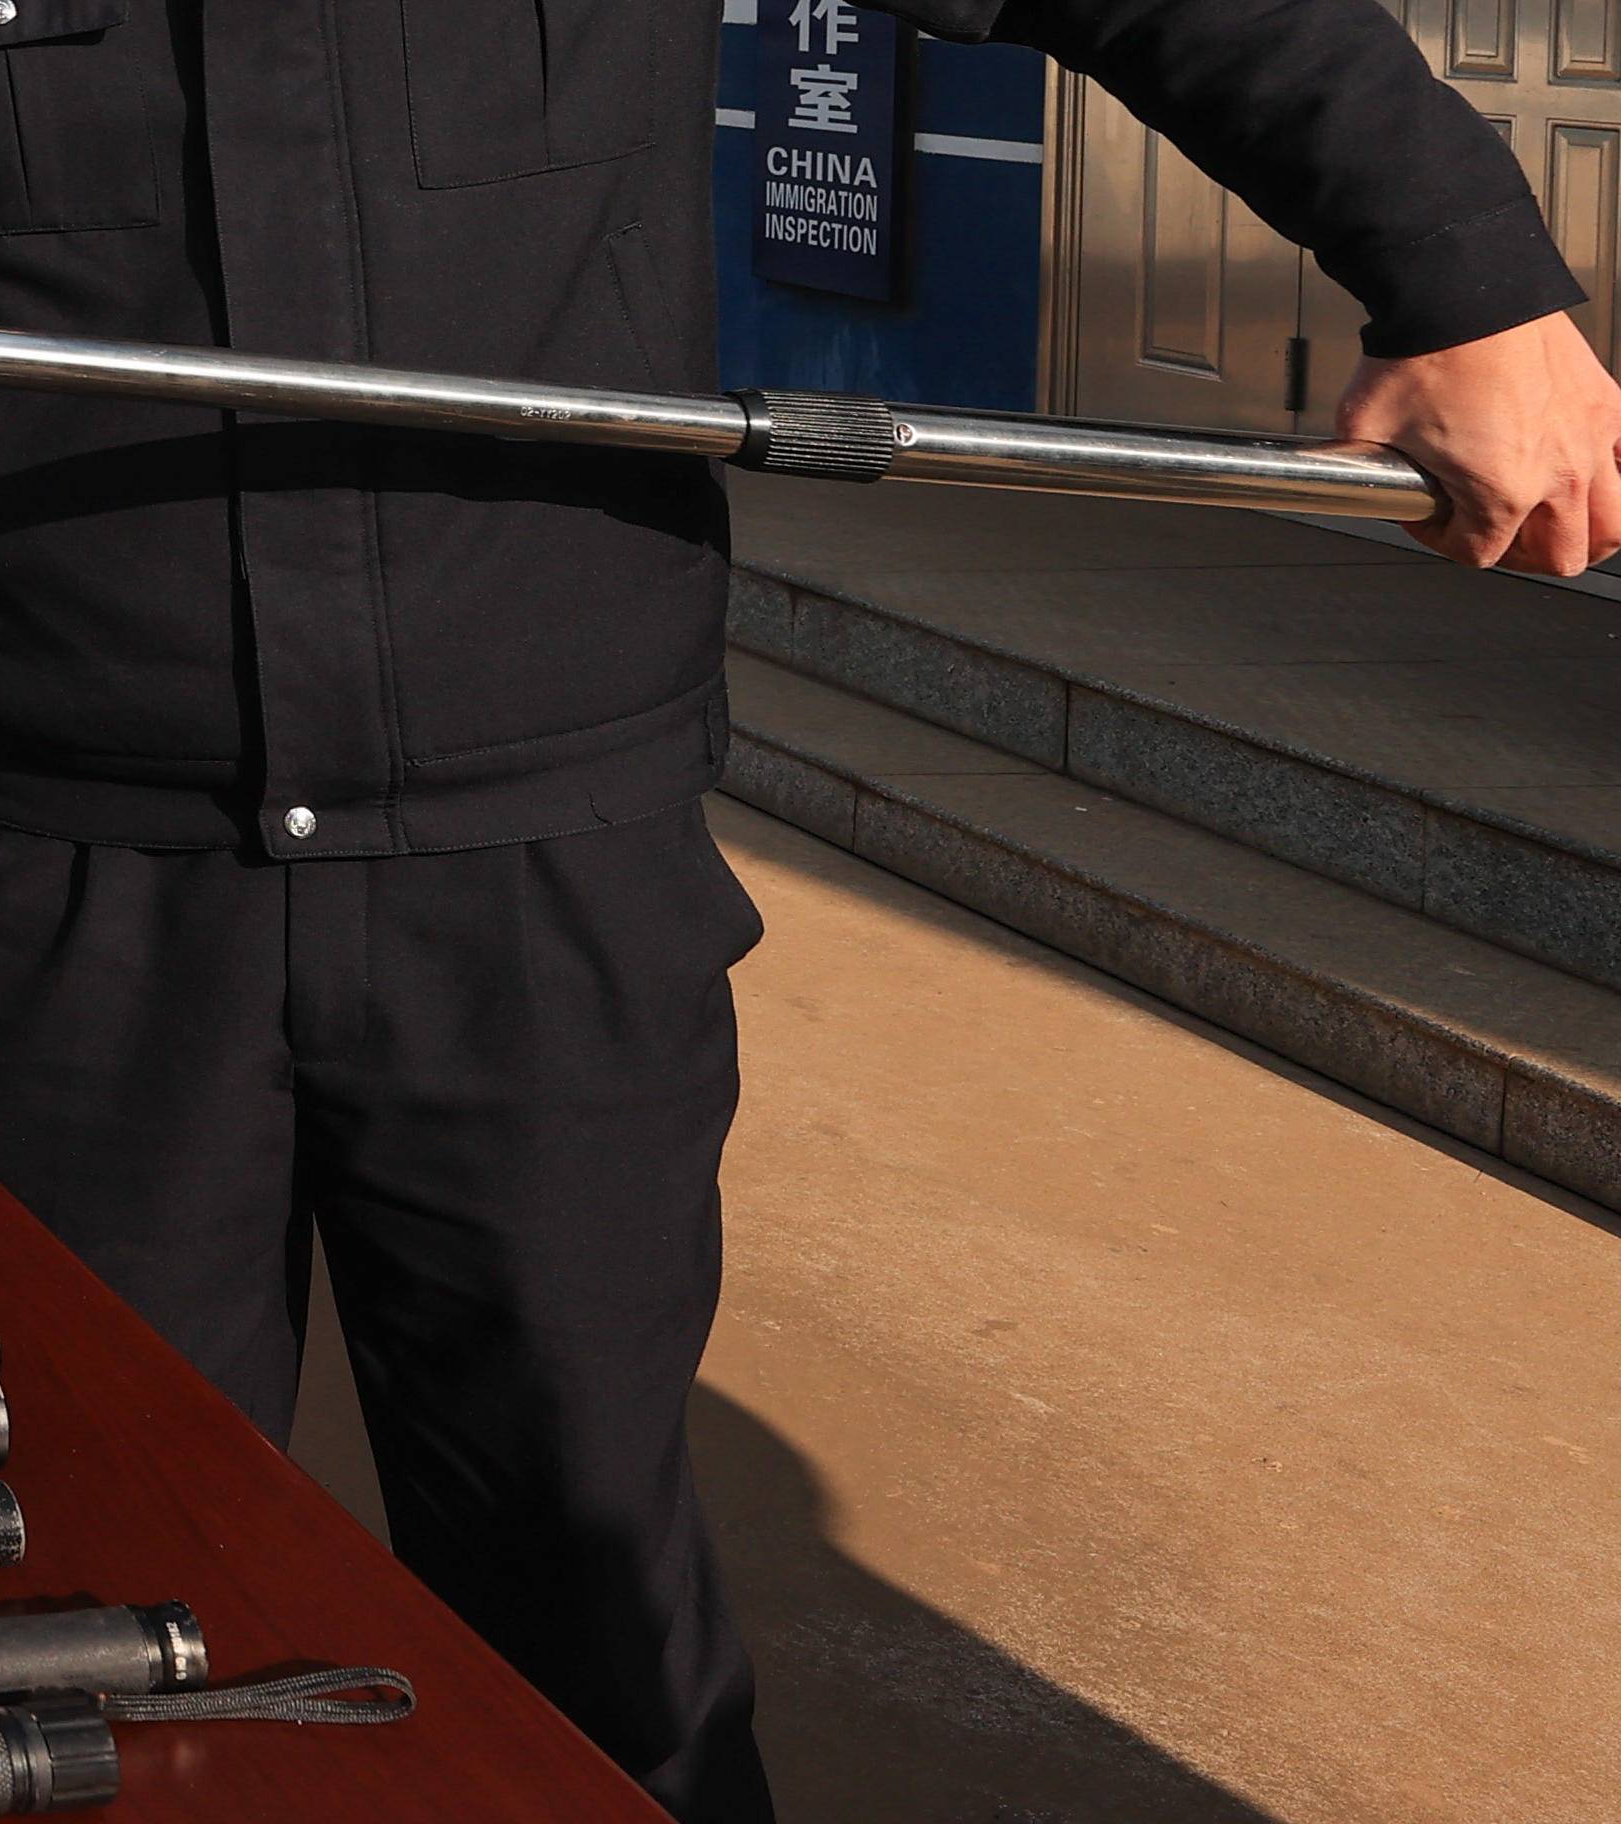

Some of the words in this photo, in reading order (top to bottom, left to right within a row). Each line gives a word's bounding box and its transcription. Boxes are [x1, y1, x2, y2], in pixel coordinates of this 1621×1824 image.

[766, 146, 878, 189] CHINA
[765, 181, 878, 223] IMMIGRATION
[764, 213, 877, 256] INSPECTION
